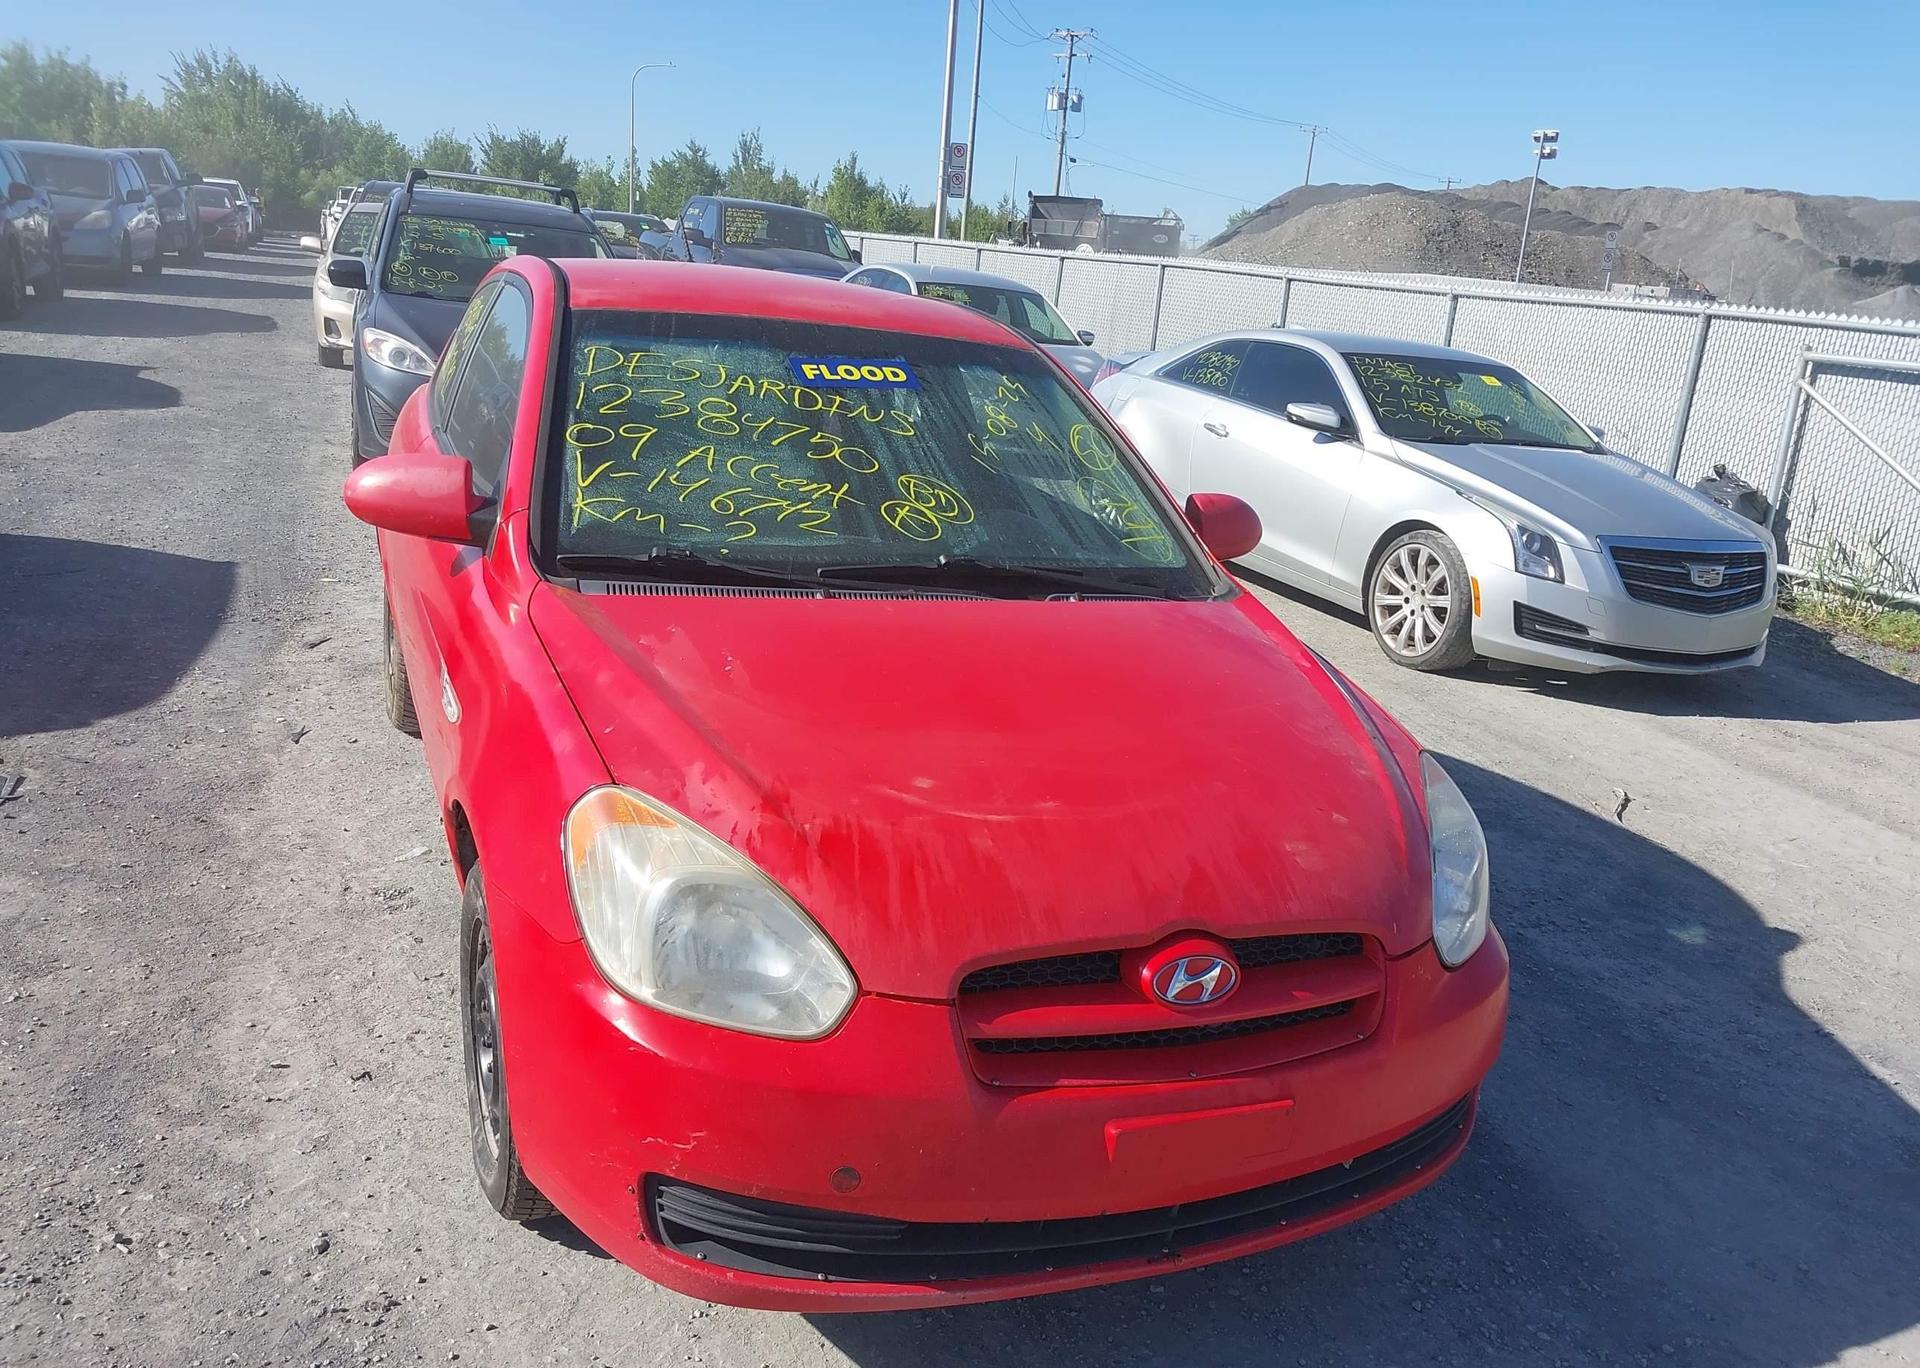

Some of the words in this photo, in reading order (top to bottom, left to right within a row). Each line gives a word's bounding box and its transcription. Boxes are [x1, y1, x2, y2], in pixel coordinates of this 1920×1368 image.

[801, 363, 908, 383] FLOOD
[1349, 356, 1416, 374] INTACT
[579, 345, 915, 436] DESJARDINS
[1401, 384, 1440, 402] ATS
[565, 423, 658, 460] 09
[575, 382, 879, 474] 12384750
